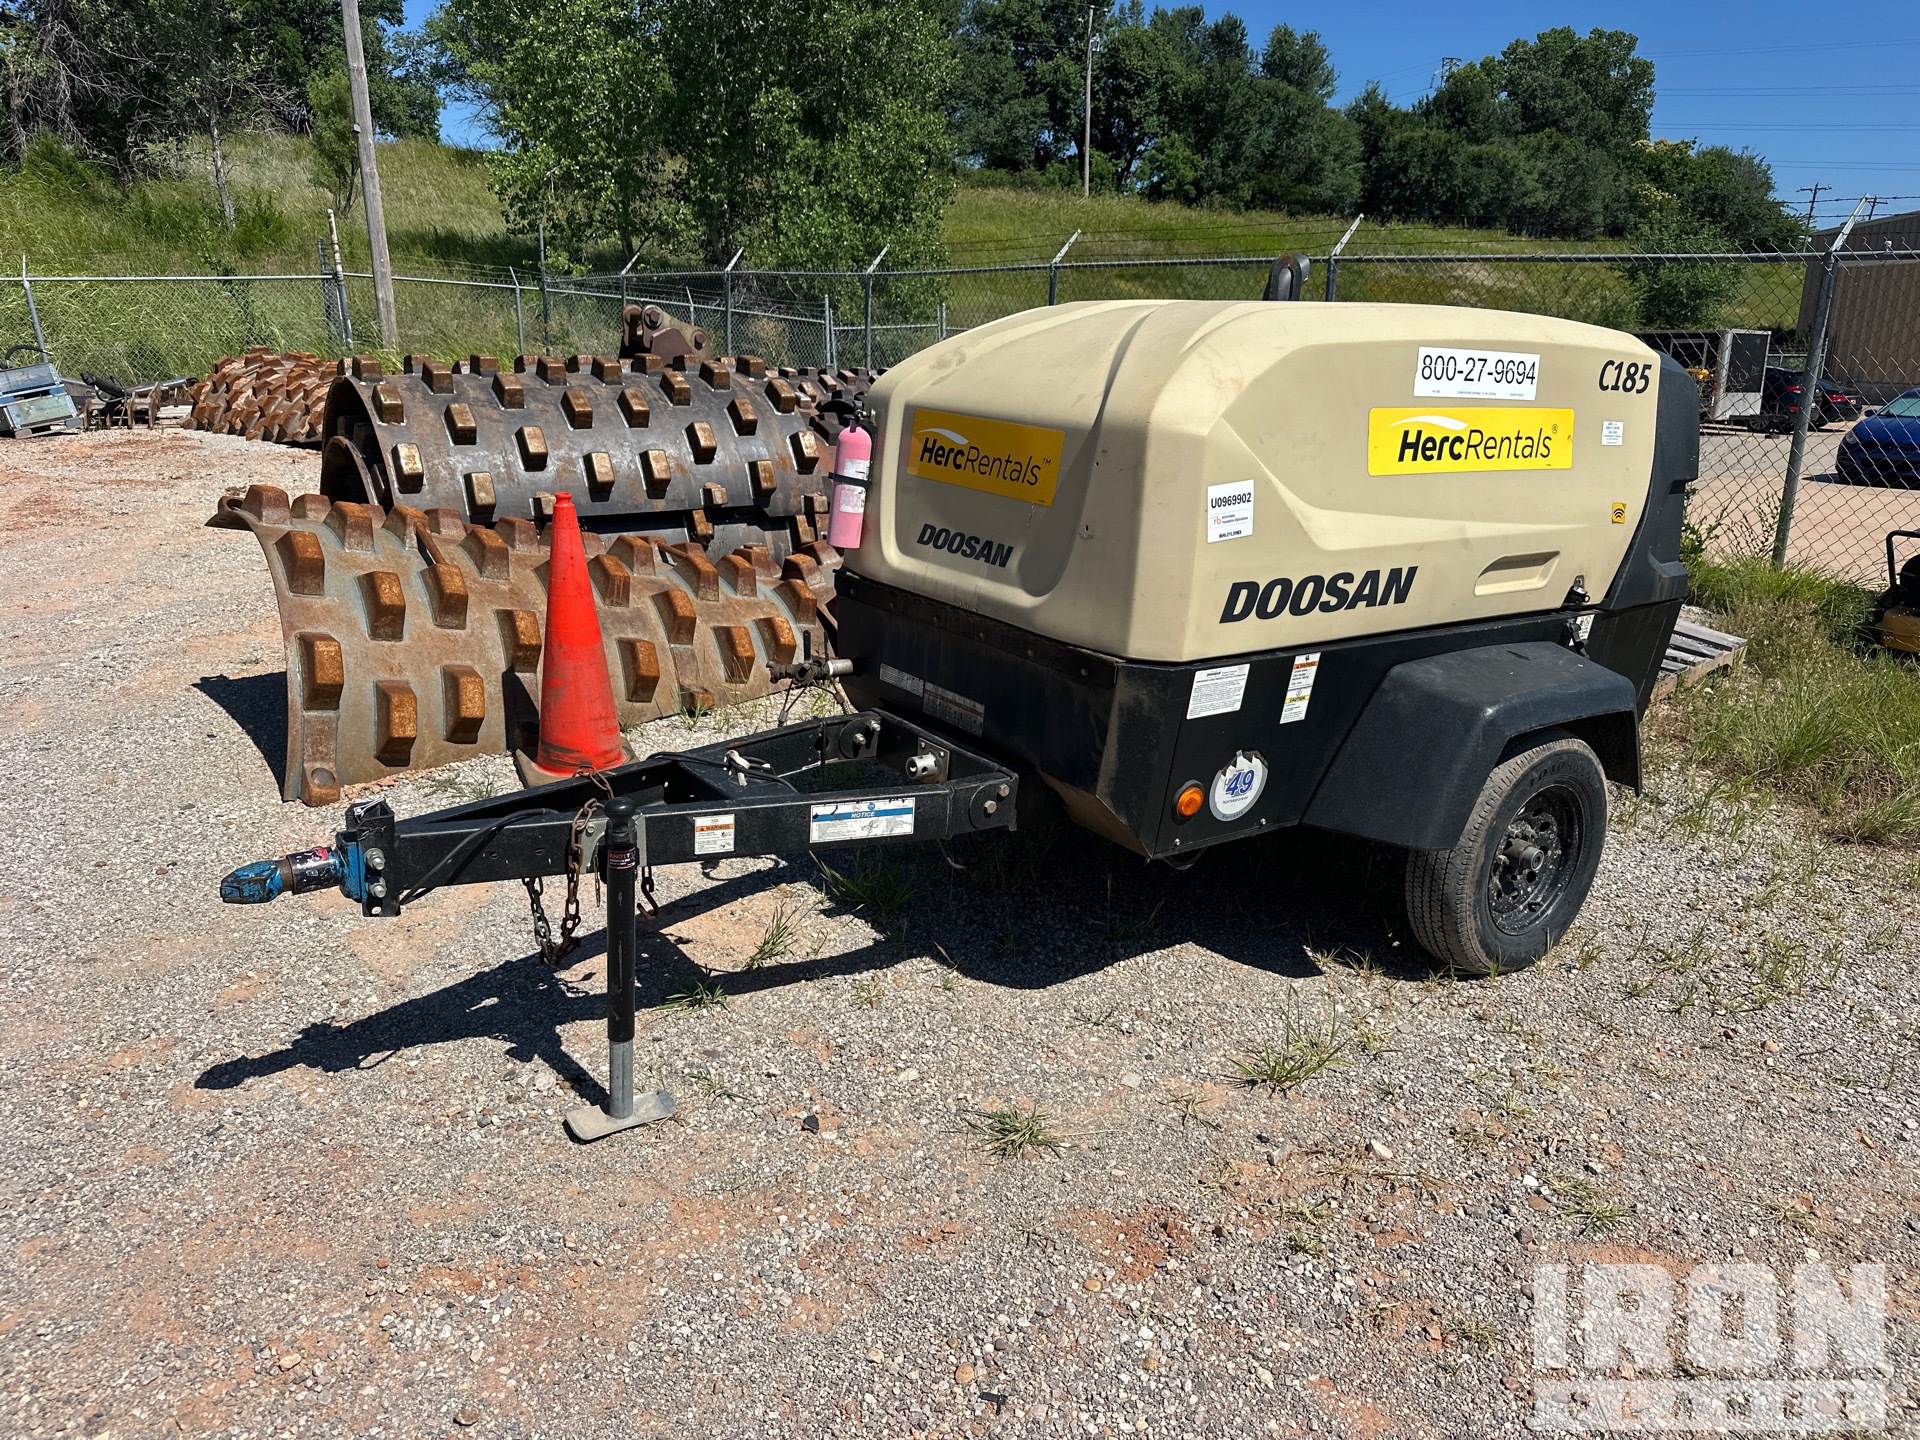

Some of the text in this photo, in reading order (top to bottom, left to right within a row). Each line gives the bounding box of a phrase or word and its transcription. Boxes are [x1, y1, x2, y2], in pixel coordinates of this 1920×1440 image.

[1421, 354, 1536, 385] 800-27-9694
[1598, 359, 1652, 395] C185
[1210, 492, 1252, 509] U0969902
[916, 523, 1014, 568] DOOSAN
[1219, 565, 1418, 624] DOOSAN
[1225, 769, 1255, 796] 49
[705, 823, 731, 831] WARNING
[850, 811, 876, 819] NOTICE
